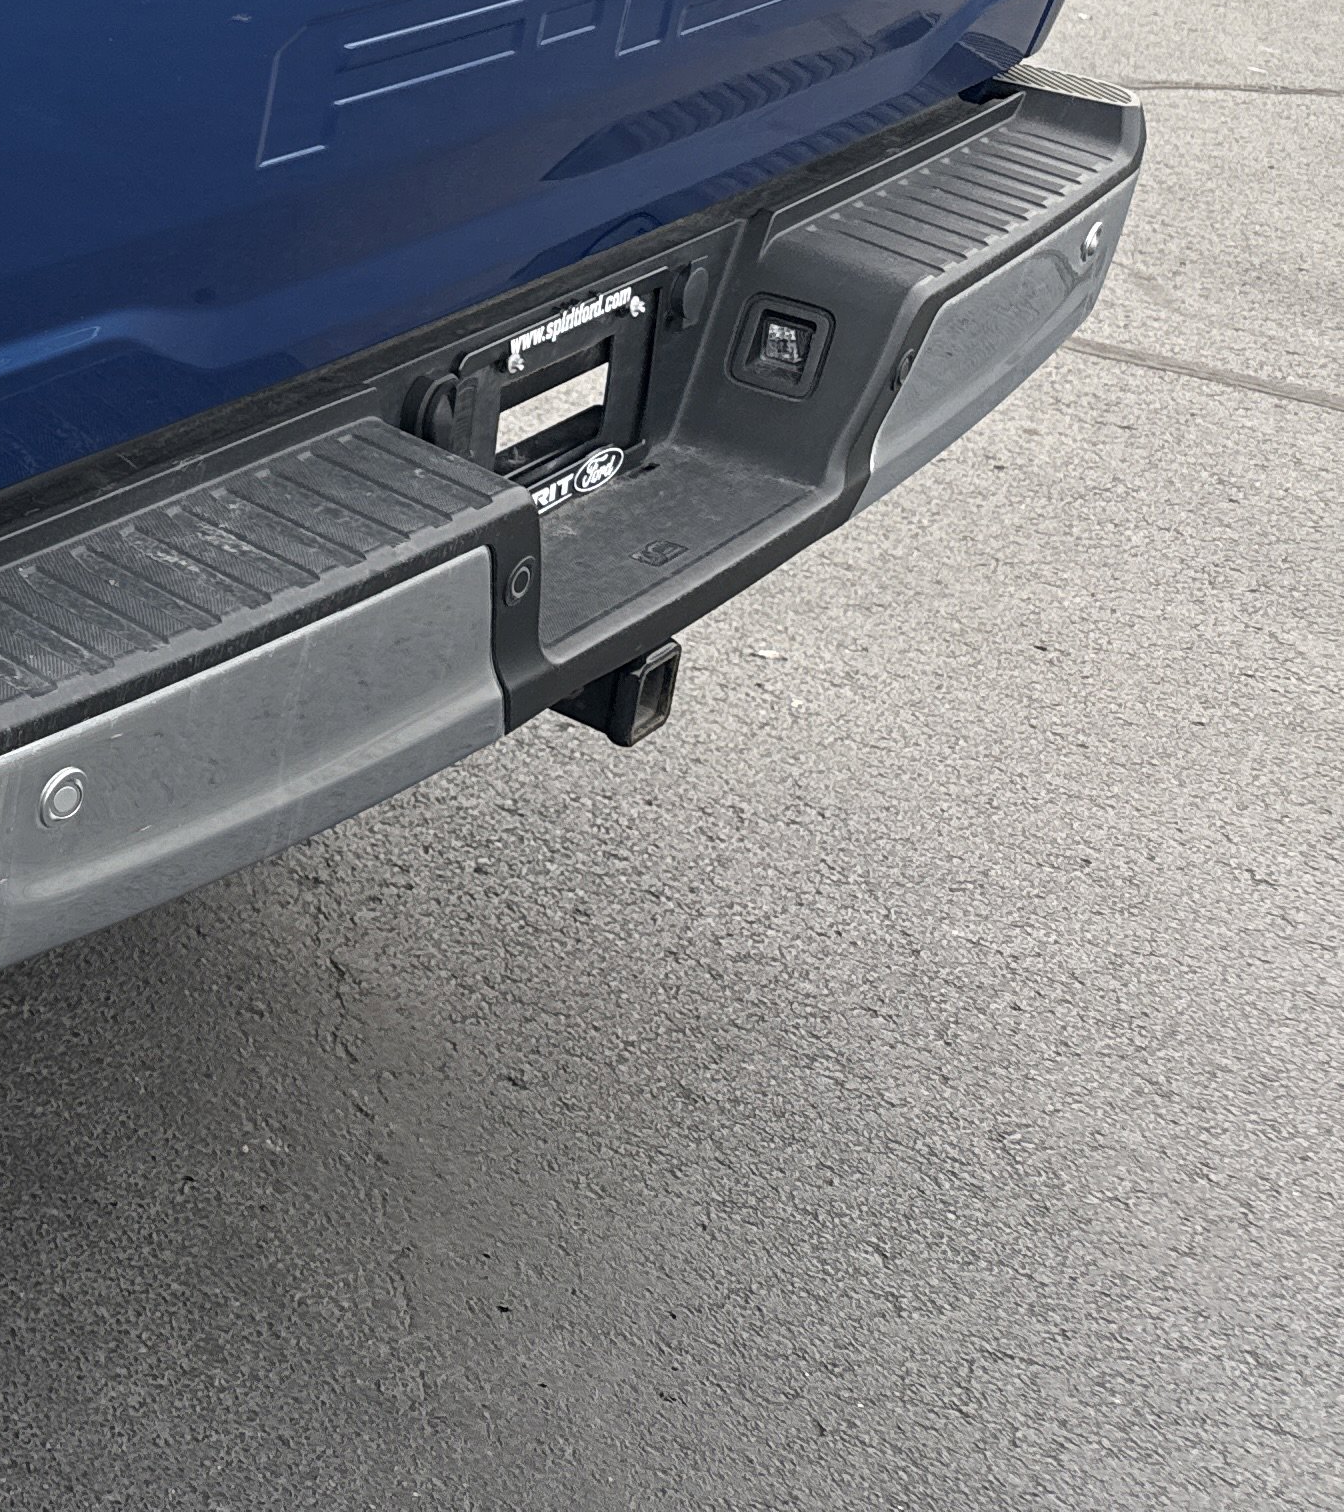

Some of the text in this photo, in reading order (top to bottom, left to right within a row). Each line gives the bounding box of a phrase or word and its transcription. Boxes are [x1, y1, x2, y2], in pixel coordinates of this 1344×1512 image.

[510, 286, 632, 354] www.spiritford.com
[531, 452, 617, 506] RIT Ford
